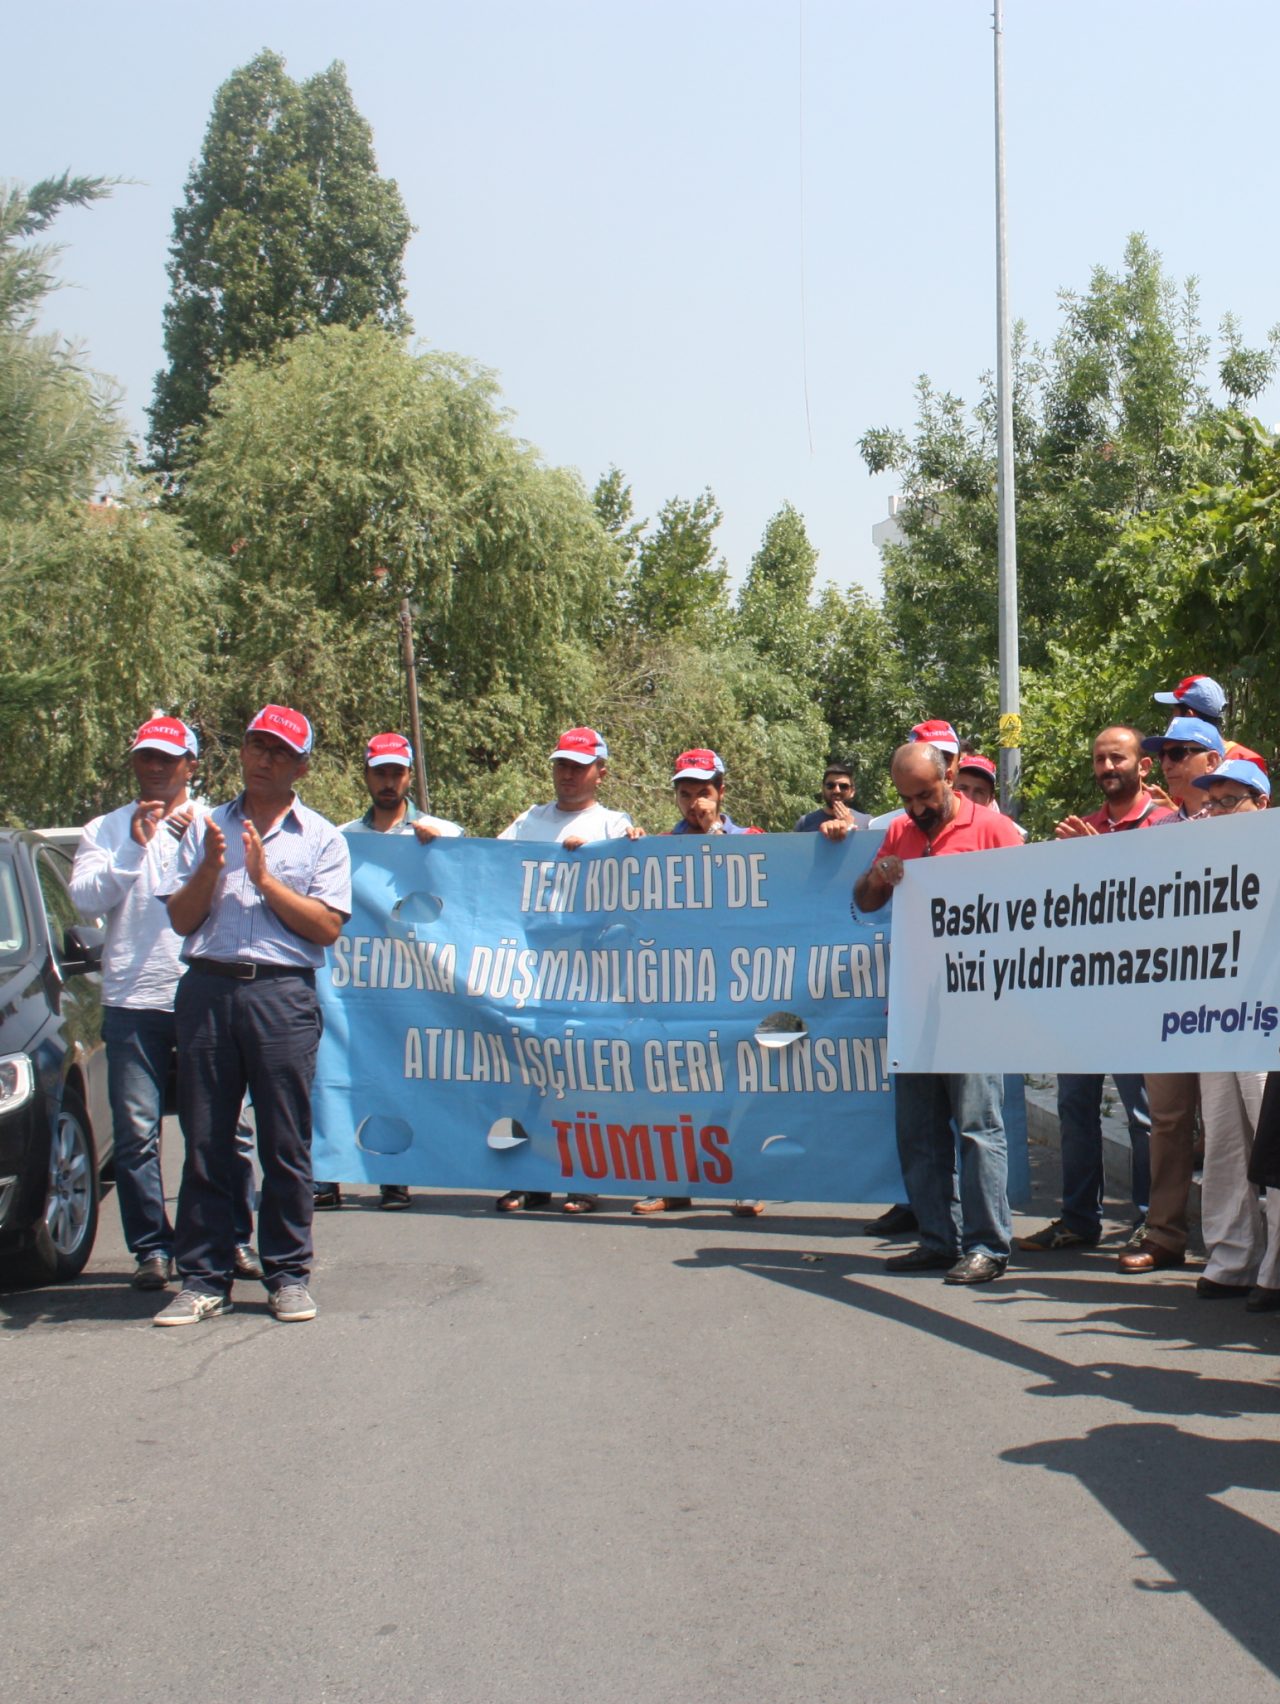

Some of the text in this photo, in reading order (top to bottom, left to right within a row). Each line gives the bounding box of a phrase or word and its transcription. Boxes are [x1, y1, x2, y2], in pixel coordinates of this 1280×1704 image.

[520, 858, 580, 913] TEM
[930, 864, 1260, 938] Baskı ve tehditlerinizle
[332, 931, 457, 995] SENDİKA
[466, 937, 717, 1009] DÜŞMANLIĞINA
[729, 945, 796, 1002] SON
[945, 929, 1241, 1001] bizi yıldıramazsınız!
[1161, 1001, 1279, 1042] petrol-iş
[403, 1026, 891, 1100] ATILAN İŞÇİLER GERİ ALINSIN!
[551, 1111, 733, 1184] TÜMTİS
